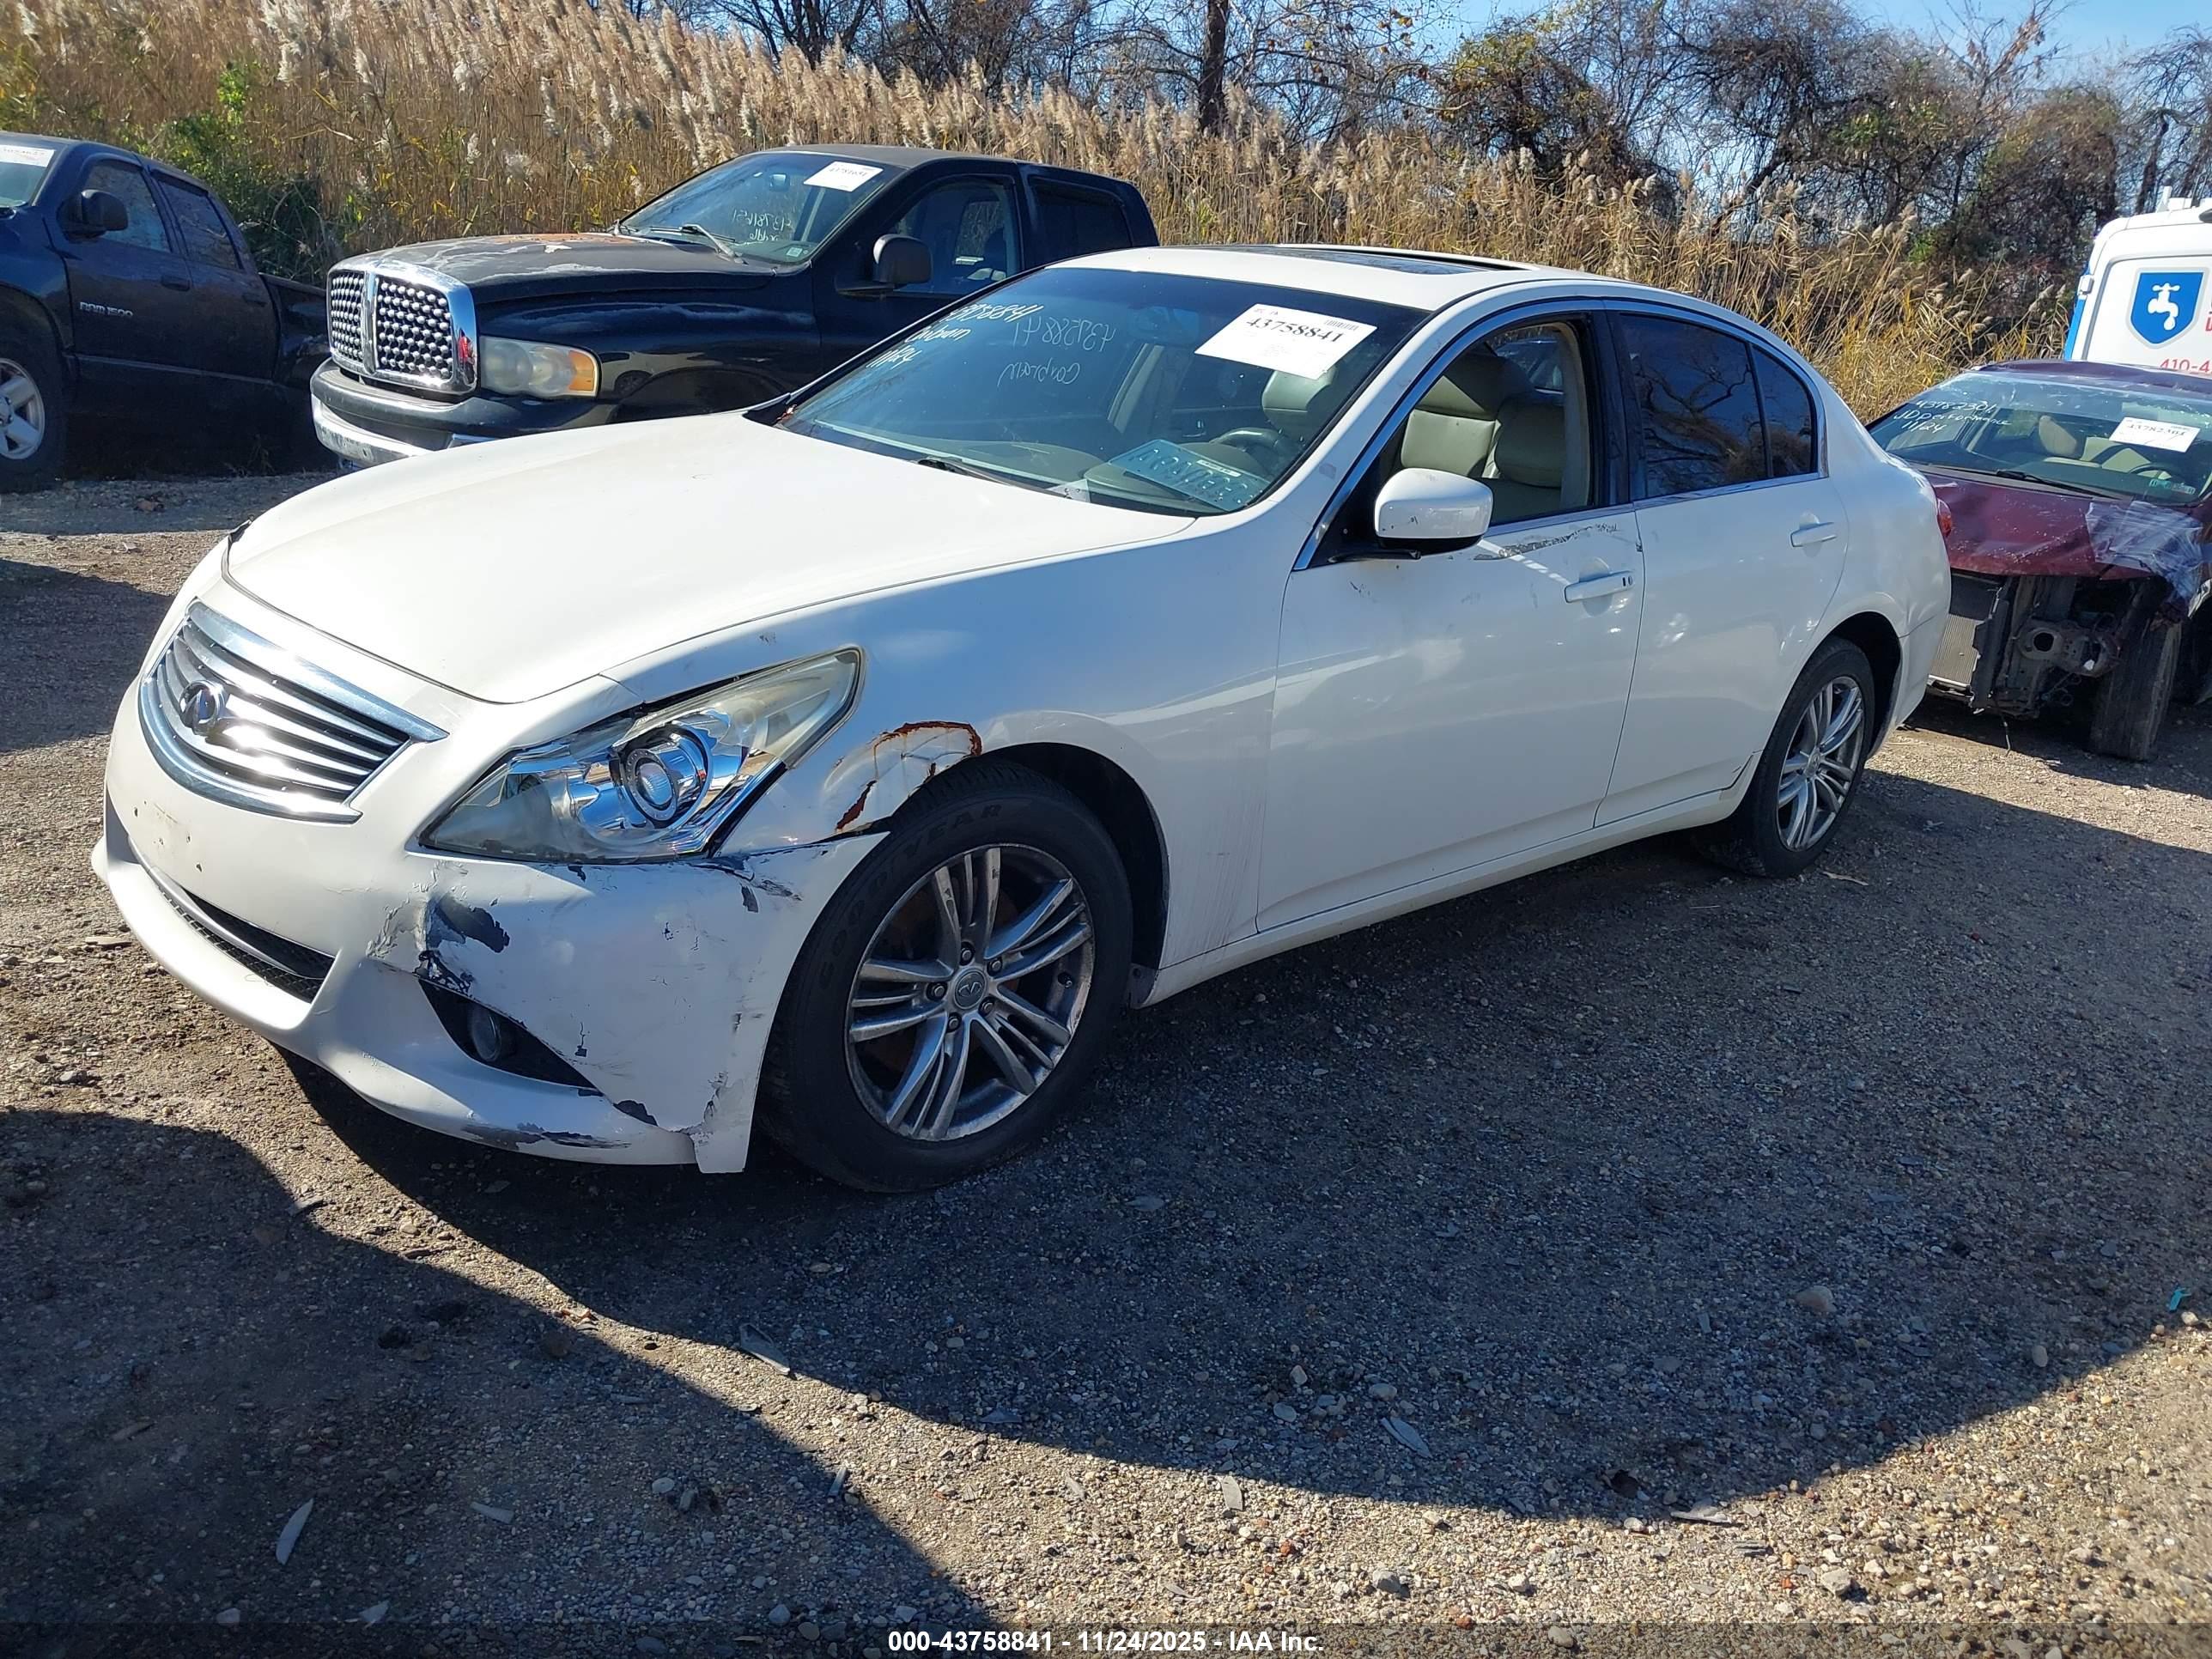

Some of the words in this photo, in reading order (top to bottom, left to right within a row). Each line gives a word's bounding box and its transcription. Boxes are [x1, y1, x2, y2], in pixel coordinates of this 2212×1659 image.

[79, 301, 106, 313] RAM
[106, 306, 134, 317] 1500
[1245, 316, 1346, 343] 43758841
[2160, 358, 2212, 373] 410-4
[1901, 420, 1948, 434] 11/24
